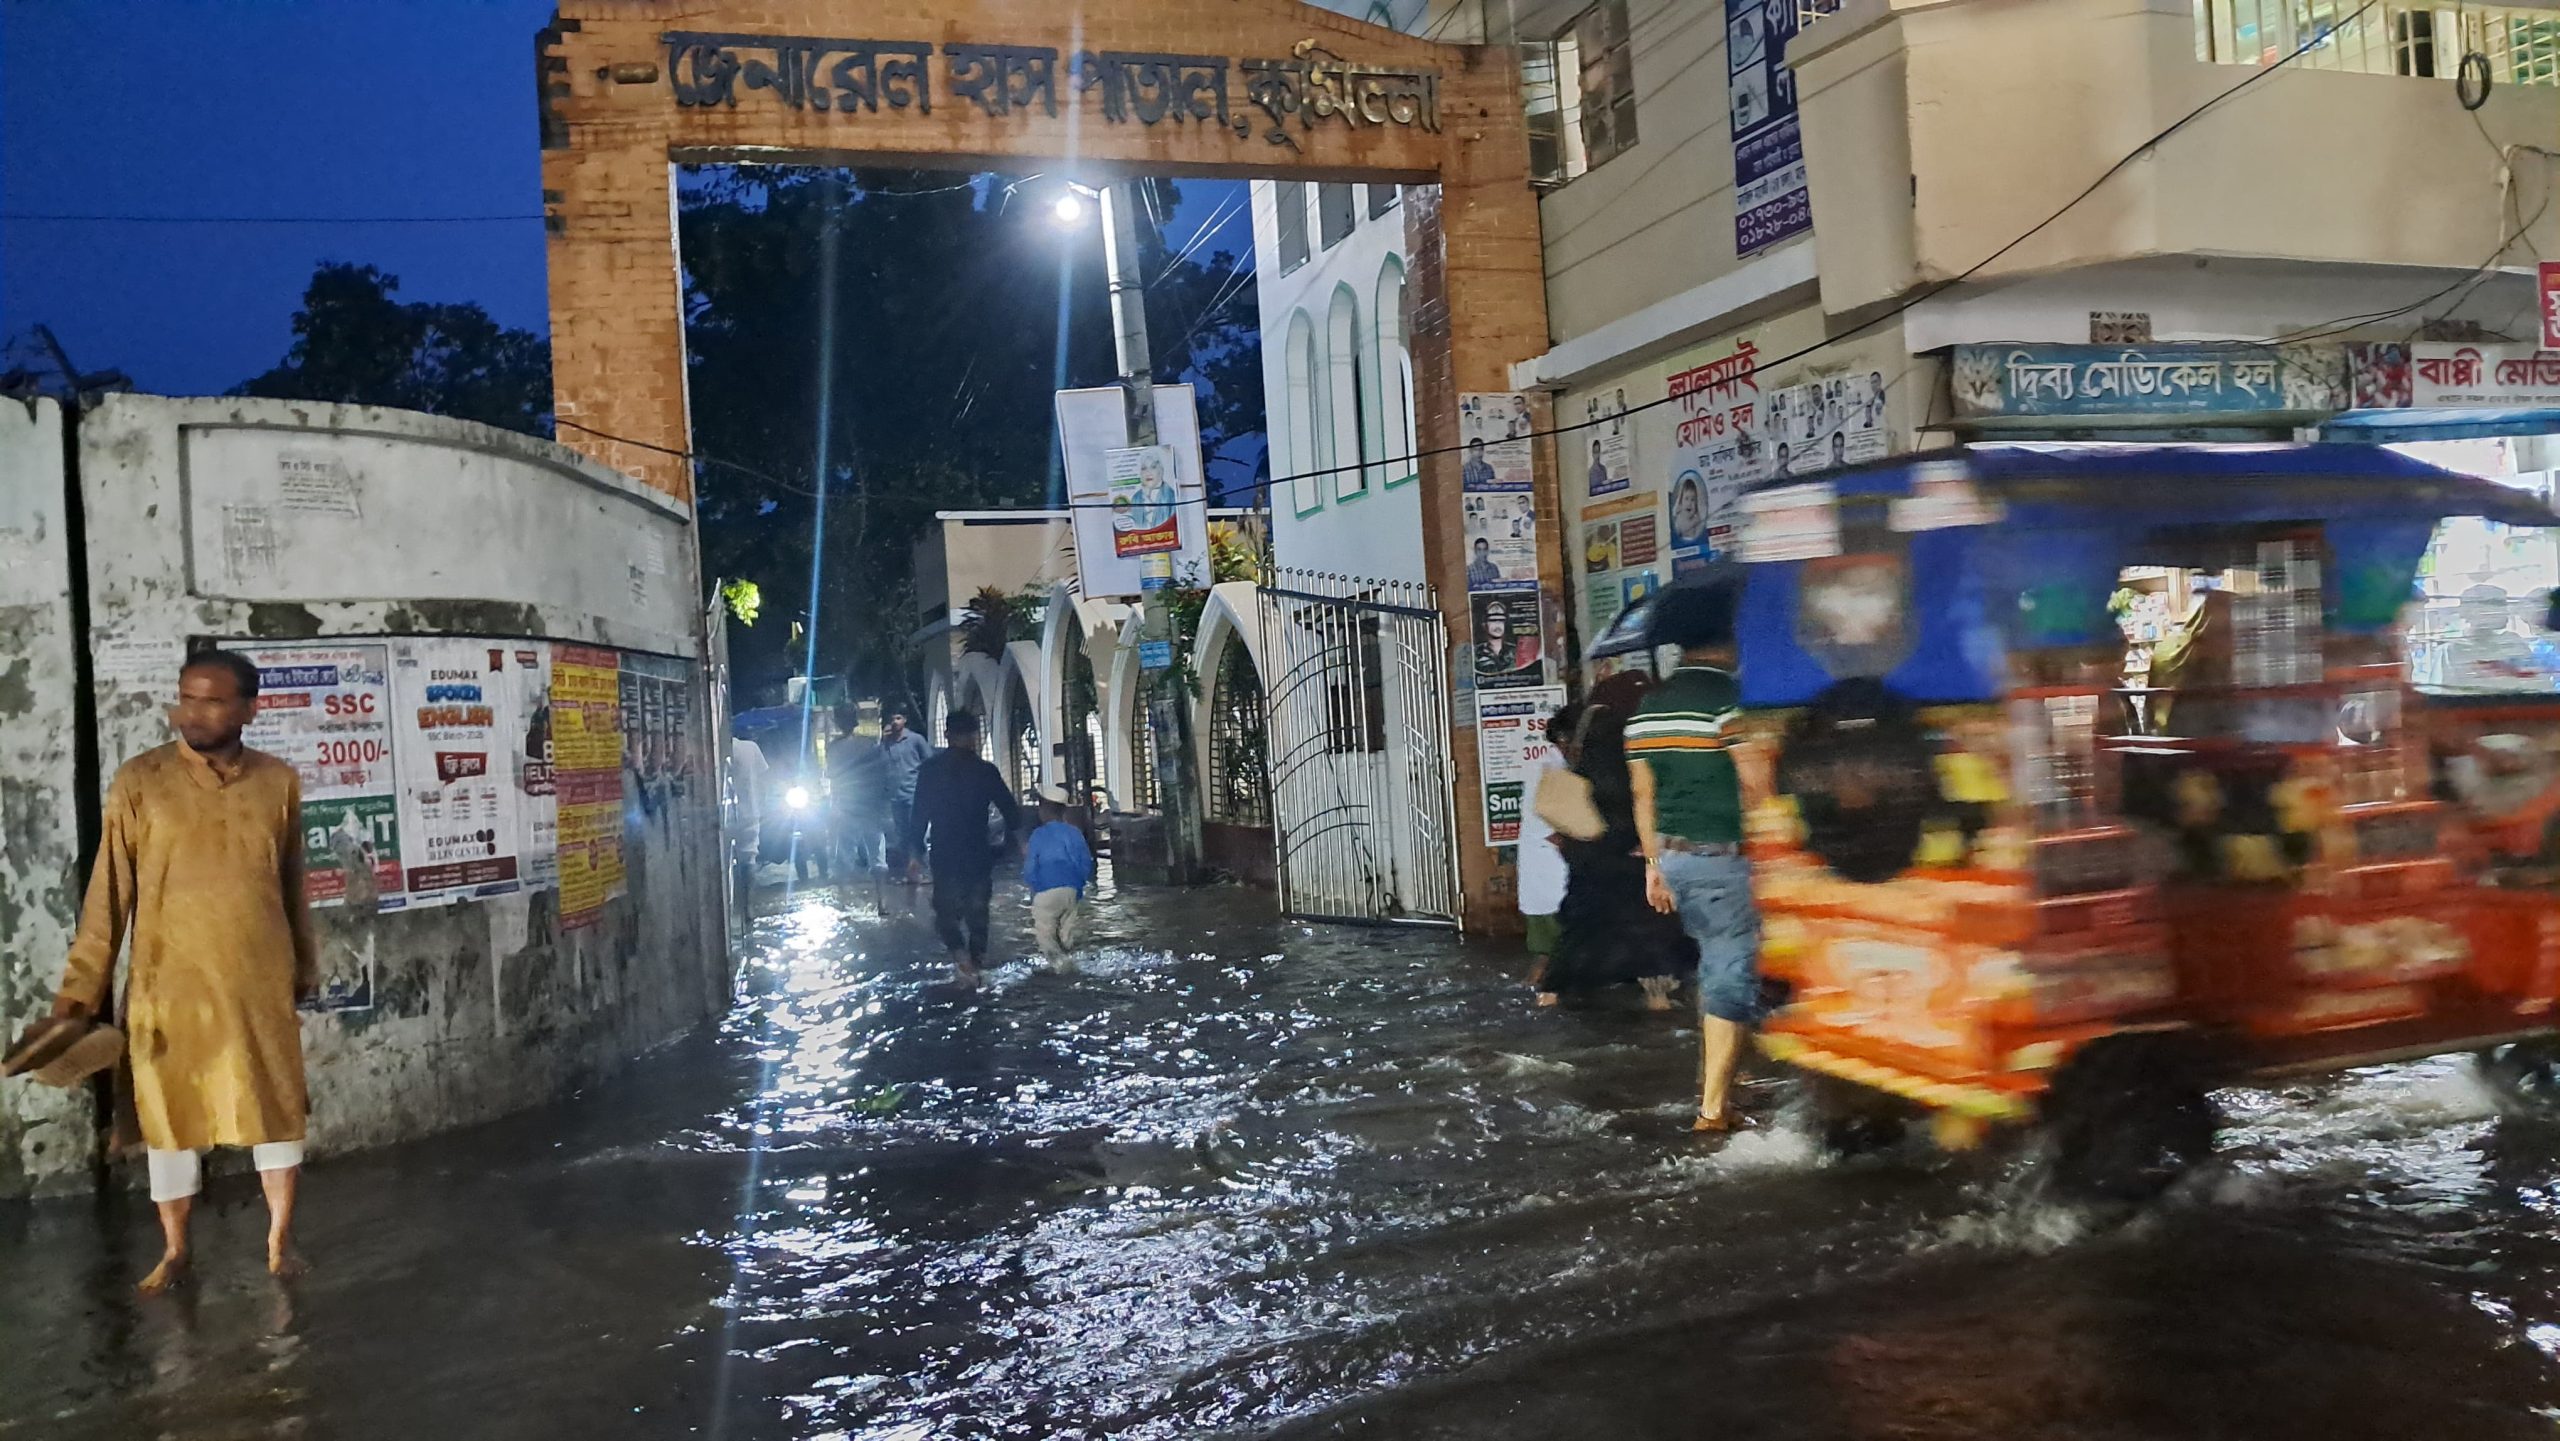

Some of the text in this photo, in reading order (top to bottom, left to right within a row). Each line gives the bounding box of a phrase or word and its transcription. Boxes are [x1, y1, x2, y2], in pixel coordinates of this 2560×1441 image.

[661, 30, 933, 114] জেনারেল
[1241, 38, 1442, 155] কুমিল্লা
[2080, 349, 2222, 398] মেডিকেল
[2228, 360, 2279, 399] হল
[1676, 401, 1755, 449] হোমিও হল
[430, 669, 479, 681] EDUMAX
[325, 692, 376, 715] SSC
[416, 705, 494, 731] ENGLISH
[317, 738, 390, 767] 3000/-
[427, 833, 476, 848] EDUMAX
